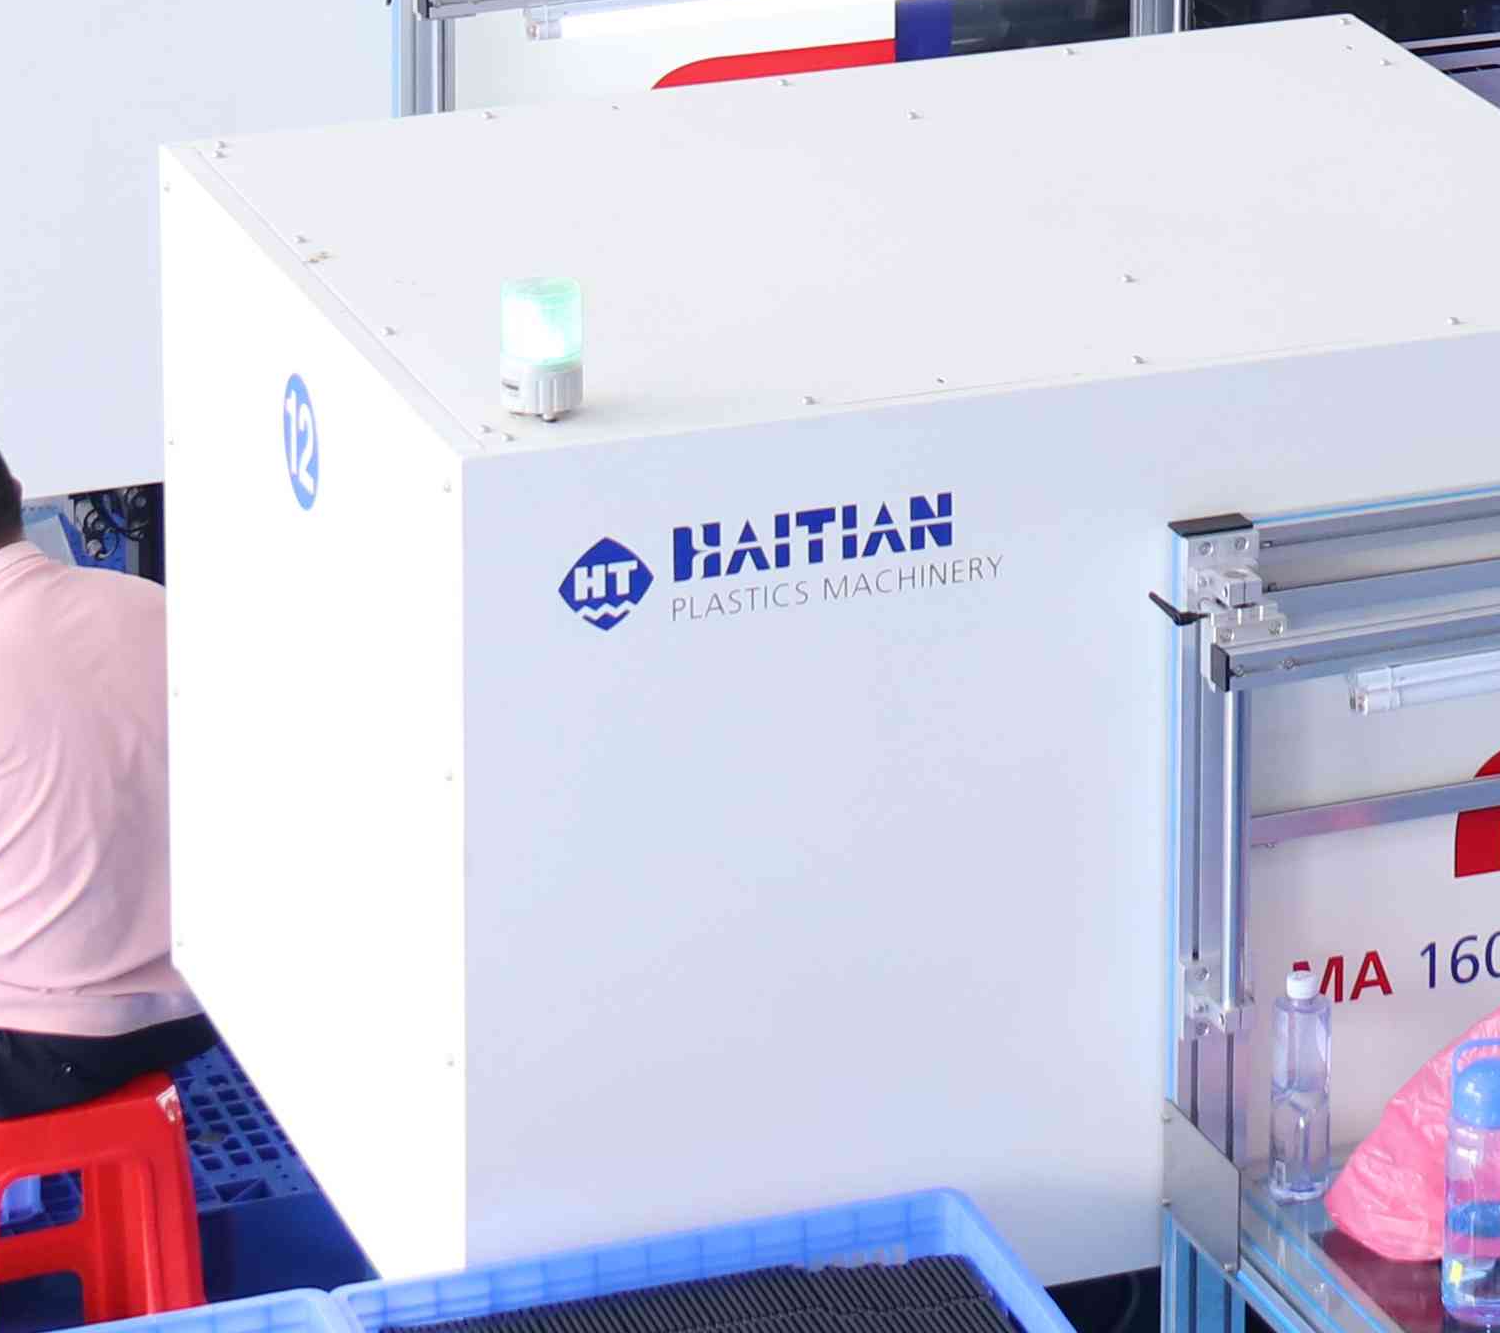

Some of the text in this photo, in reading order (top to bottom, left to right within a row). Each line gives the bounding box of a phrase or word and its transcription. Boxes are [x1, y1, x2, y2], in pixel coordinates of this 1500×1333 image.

[287, 391, 318, 496] 12
[673, 492, 953, 583] HAITIAN
[671, 554, 1005, 622] PLASTICS MACHINERY
